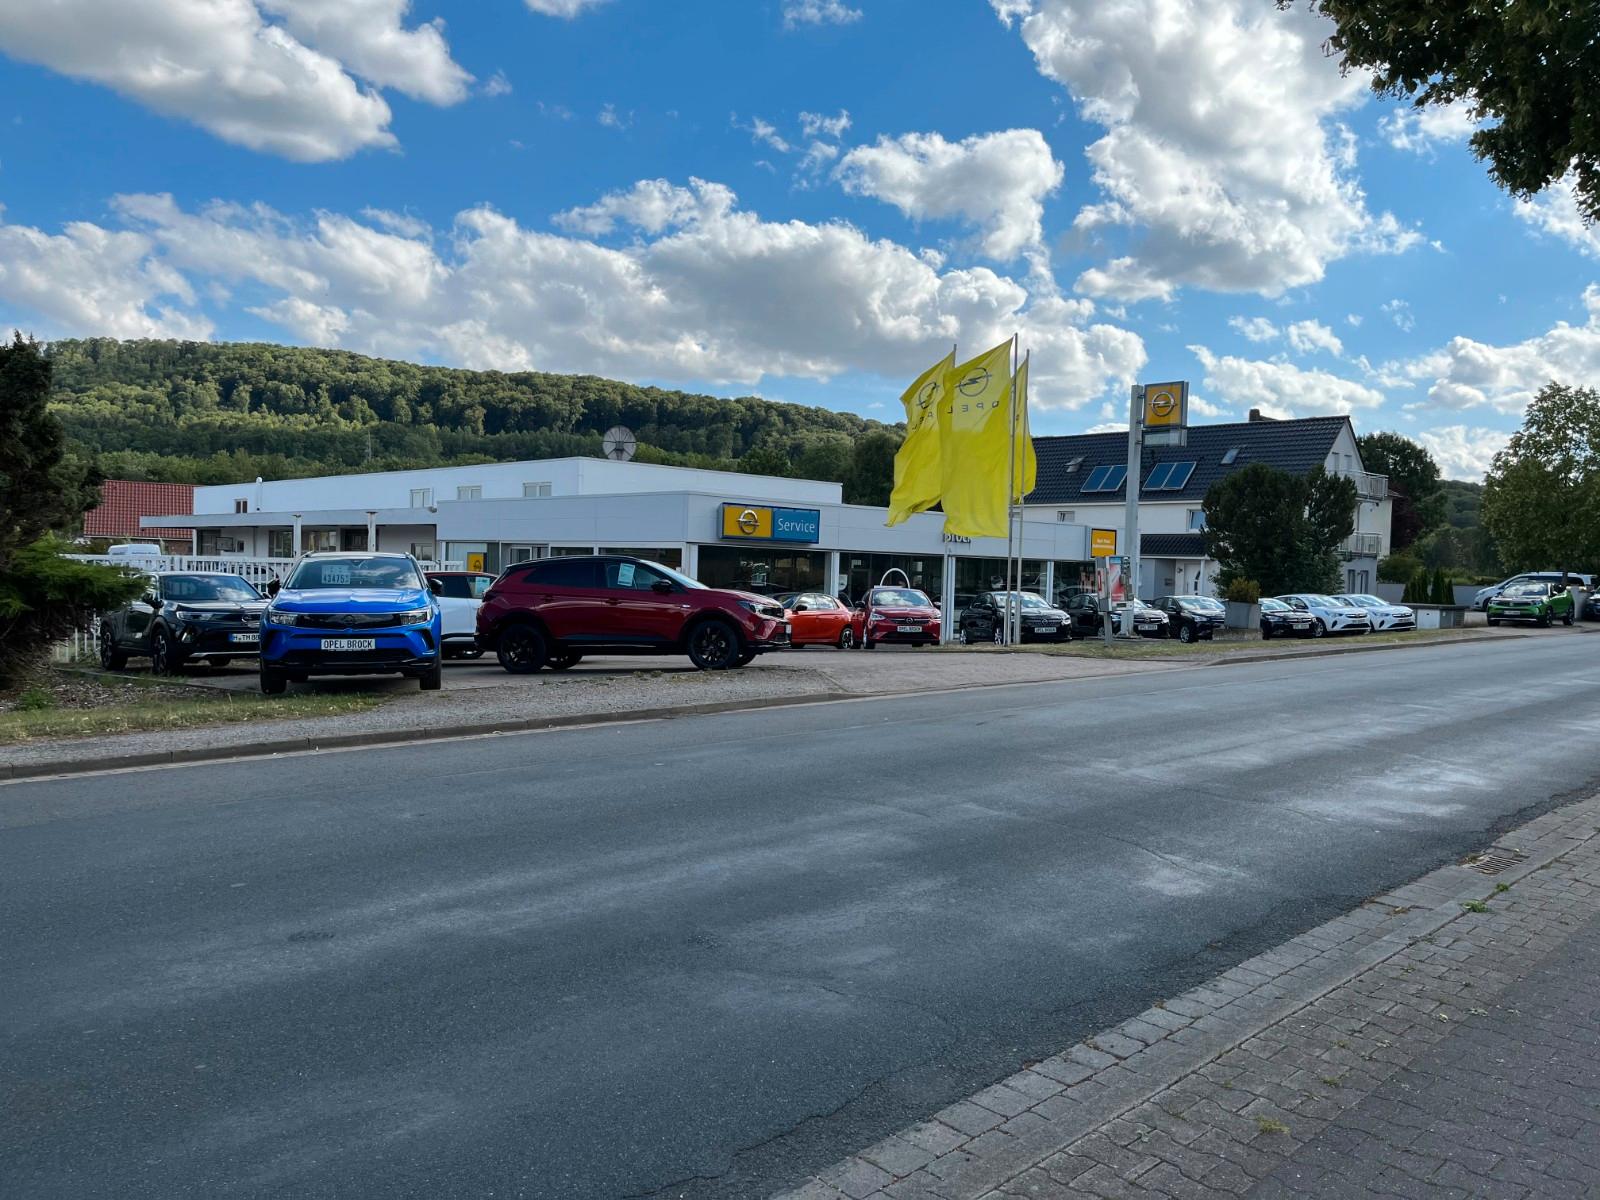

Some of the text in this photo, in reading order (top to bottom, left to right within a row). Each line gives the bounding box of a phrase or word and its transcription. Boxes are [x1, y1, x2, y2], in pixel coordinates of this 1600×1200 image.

[777, 518, 815, 533] Service
[324, 640, 373, 649] OPEL BROCK
